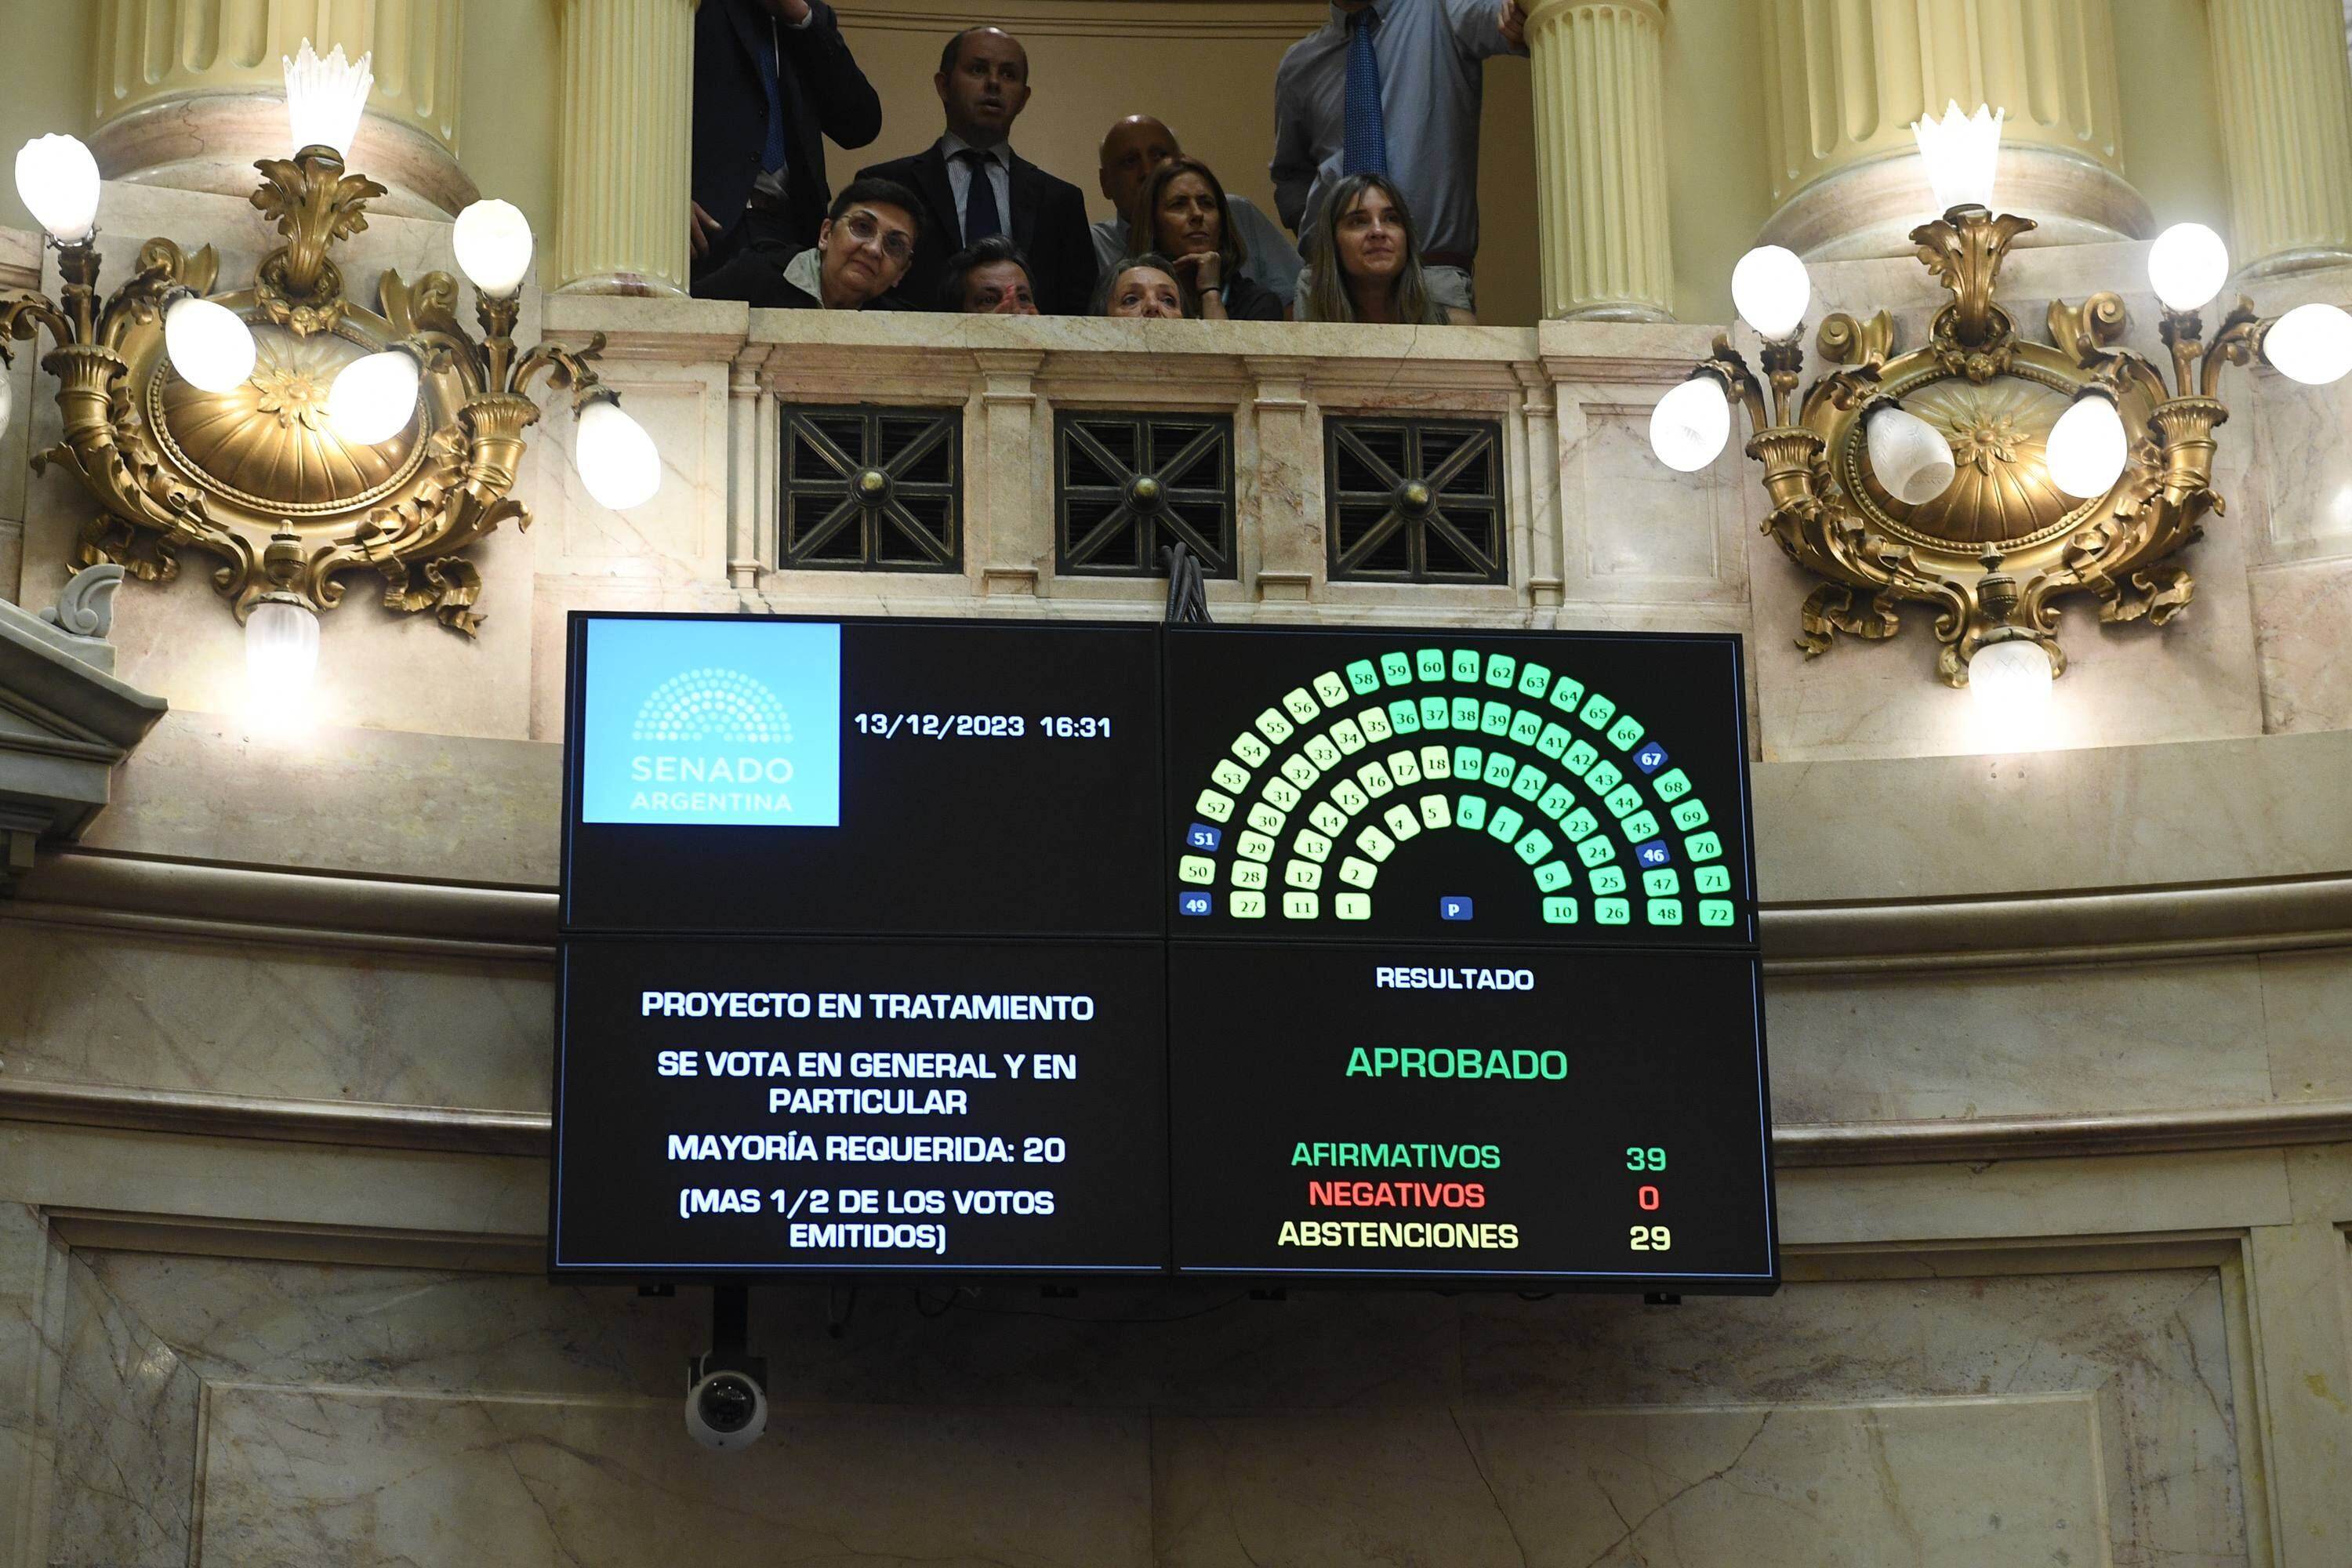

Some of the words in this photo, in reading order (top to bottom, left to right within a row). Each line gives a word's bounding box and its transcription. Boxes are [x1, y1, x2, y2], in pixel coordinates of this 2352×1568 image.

[1388, 666, 1406, 677] 59
[1423, 662, 1442, 673] 60
[1458, 662, 1476, 674] 61
[1492, 667, 1511, 678] 62
[1355, 673, 1373, 685] 58
[1526, 677, 1544, 688] 63
[1323, 686, 1341, 697] 57
[1559, 691, 1578, 702] 64
[1294, 702, 1312, 713] 56
[1396, 713, 1415, 725] 36
[1426, 710, 1444, 721] 37
[1457, 710, 1475, 721] 38
[1589, 708, 1607, 720] 65
[855, 713, 1024, 739] 13/12/2023
[1040, 717, 1109, 737] 16:31
[1488, 715, 1507, 726] 39
[1266, 722, 1285, 733] 55
[1367, 721, 1385, 732] 35
[1518, 724, 1537, 735] 40
[1340, 733, 1358, 745] 34
[1617, 729, 1636, 740] 66
[1545, 737, 1563, 748] 41
[1243, 746, 1261, 757] 54
[1314, 749, 1333, 760] 33
[1429, 759, 1446, 770] 18
[1572, 754, 1591, 765] 42
[1641, 753, 1661, 765] 67
[631, 755, 793, 784] SENADO
[1398, 764, 1414, 776] 17
[1461, 760, 1478, 771] 19
[1292, 768, 1311, 780] 32
[1491, 767, 1510, 779] 20
[1223, 773, 1242, 785] 53
[1369, 776, 1385, 788] 16
[1522, 779, 1539, 790] 21
[1595, 775, 1613, 786] 43
[1664, 782, 1682, 793] 68
[630, 791, 792, 813] ARGENTINA
[1273, 791, 1290, 802] 31
[1343, 794, 1359, 805] 15
[1207, 802, 1226, 814] 52
[1548, 798, 1567, 809] 22
[1615, 797, 1634, 808] 44
[1428, 808, 1436, 819] 5
[1463, 809, 1472, 820] 6
[1682, 811, 1701, 822] 69
[1258, 816, 1277, 827] 30
[1322, 816, 1339, 828] 14
[1395, 819, 1403, 830] 4
[1497, 821, 1506, 833] 7
[1571, 821, 1589, 833] 23
[1633, 822, 1651, 834] 45
[1194, 833, 1214, 846] 51
[1247, 843, 1266, 854] 29
[1307, 843, 1323, 854] 13
[1367, 840, 1376, 851] 3
[1526, 843, 1535, 854] 8
[1696, 843, 1715, 854] 70
[1589, 847, 1607, 858] 24
[1643, 849, 1664, 862] 46
[1189, 866, 1207, 877] 50
[1241, 871, 1260, 882] 28
[1296, 871, 1313, 883] 12
[1351, 869, 1359, 880] 2
[1544, 873, 1554, 884] 9
[1600, 877, 1619, 888] 25
[1653, 878, 1671, 890] 47
[1705, 875, 1722, 886] 71
[1186, 900, 1207, 912] 49
[1241, 902, 1258, 913] 27
[1294, 902, 1310, 913] 11
[1347, 902, 1353, 913] 1
[1448, 904, 1460, 916] P
[1555, 907, 1572, 918] 10
[1606, 907, 1624, 919] 26
[1657, 908, 1676, 920] 48
[1710, 909, 1728, 920] 72
[1377, 967, 1534, 990] RESULTADO
[642, 992, 811, 1018] PROYECTO
[818, 993, 861, 1018] EN
[869, 994, 1094, 1020] TRATAMIENTO
[658, 1051, 698, 1076] SE
[705, 1051, 791, 1076] VOTA
[798, 1052, 841, 1077] EN
[851, 1053, 996, 1078] GENERAL
[1004, 1054, 1025, 1078] Y
[1034, 1054, 1076, 1079] EN
[1346, 1047, 1567, 1080] APROBADO
[770, 1088, 967, 1114] PARTICULAR
[668, 1131, 818, 1160] MAYORÍA
[826, 1136, 1014, 1162] REQUERIDA:
[1024, 1138, 1065, 1162] 20
[1291, 1143, 1500, 1168] AFIRMATIVOS
[1627, 1148, 1666, 1171] 39
[1310, 1181, 1485, 1207] NEGATIVOS
[1639, 1186, 1659, 1210] 0
[681, 1189, 760, 1218] (MAS
[770, 1189, 829, 1219] 1/2
[839, 1189, 879, 1213] DE
[887, 1190, 946, 1214] LOS
[953, 1190, 1054, 1214] VOTOS
[790, 1224, 946, 1254] EMITIDOS)
[1278, 1221, 1519, 1248] ABSTENCIONES
[1630, 1226, 1670, 1250] 29
